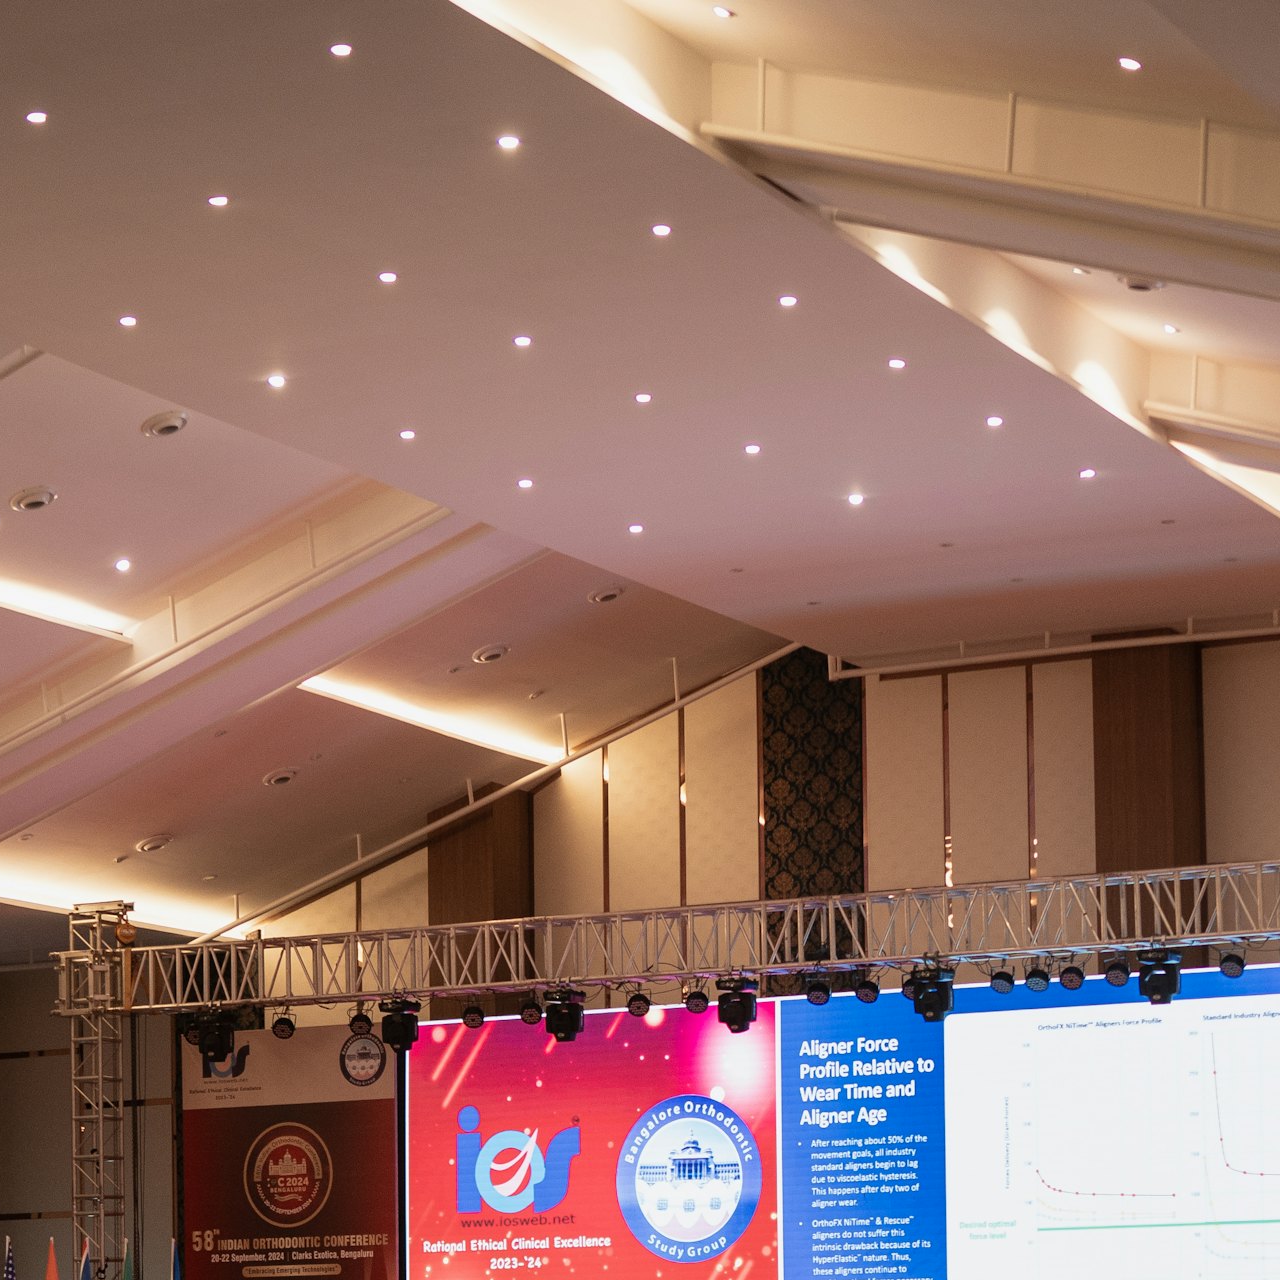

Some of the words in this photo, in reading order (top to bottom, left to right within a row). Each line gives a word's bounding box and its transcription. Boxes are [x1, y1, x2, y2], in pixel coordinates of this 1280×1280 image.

[799, 1039, 854, 1059] Aligner
[857, 1037, 898, 1053] Force
[799, 1060, 849, 1079] Profile
[852, 1057, 914, 1076] Relative
[917, 1057, 935, 1072] to
[799, 1086, 841, 1102] Wear
[843, 1083, 883, 1100] Time
[885, 1079, 916, 1098] and
[800, 1108, 854, 1128] Aligner
[857, 1106, 887, 1126] Age
[624, 1102, 681, 1164] Bangalore
[684, 1100, 753, 1162] Orthodontic
[811, 1139, 830, 1148] After
[831, 1137, 863, 1147] reaching
[864, 1136, 886, 1145] about
[887, 1135, 904, 1144] 50%
[905, 1134, 914, 1143] of
[914, 1134, 928, 1142] the
[811, 1150, 851, 1160] movement
[852, 1149, 874, 1159] goals,
[874, 1148, 884, 1157] all
[885, 1148, 916, 1157] industry
[811, 1162, 844, 1172] standard
[844, 1161, 874, 1171] aligners
[875, 1160, 896, 1170] begin
[896, 1160, 906, 1168] to
[907, 1159, 919, 1169] lag
[286, 1176, 310, 1187] 2024
[811, 1175, 826, 1184] due
[826, 1175, 836, 1183] to
[836, 1172, 879, 1183] viscoelastic
[879, 1171, 918, 1181] hysteresis.
[811, 1187, 827, 1196] This
[827, 1185, 860, 1196] happens
[860, 1184, 879, 1194] after
[879, 1184, 894, 1194] day
[894, 1183, 910, 1192] two
[910, 1182, 920, 1191] of
[811, 1199, 838, 1209] aligner
[838, 1199, 859, 1207] wear.
[460, 1214, 576, 1228] www.iosweb.net
[811, 1218, 843, 1228] OrthoFX
[875, 1216, 882, 1225] &
[812, 1230, 841, 1241] aligners
[841, 1230, 852, 1239] do
[853, 1229, 867, 1238] not
[867, 1228, 890, 1237] suffer
[890, 1228, 906, 1236] this
[217, 1238, 250, 1251] INDIAN
[252, 1236, 321, 1249] ORTHODONTIC
[324, 1233, 389, 1248] CONFERENCE
[423, 1240, 466, 1253] Rational
[470, 1238, 507, 1251] Ethical
[511, 1237, 550, 1250] Clinical
[554, 1235, 611, 1249] Excellence
[647, 1234, 684, 1259] Study
[687, 1235, 727, 1257] Group
[812, 1243, 842, 1252] intrinsic
[842, 1241, 879, 1251] drawback
[880, 1240, 911, 1249] because
[911, 1239, 921, 1248] of
[921, 1239, 931, 1248] its
[210, 1253, 230, 1263] 20-22
[231, 1252, 267, 1263] September,
[267, 1251, 285, 1261] 2024
[291, 1250, 312, 1260] Clarks
[313, 1250, 339, 1260] Exotica,
[340, 1249, 374, 1260] Bengaluru
[862, 1253, 890, 1262] nature.
[891, 1252, 912, 1262] Thus,
[812, 1266, 834, 1276] these
[834, 1266, 863, 1276] aligners
[864, 1265, 898, 1274] continue
[898, 1265, 908, 1273] to
